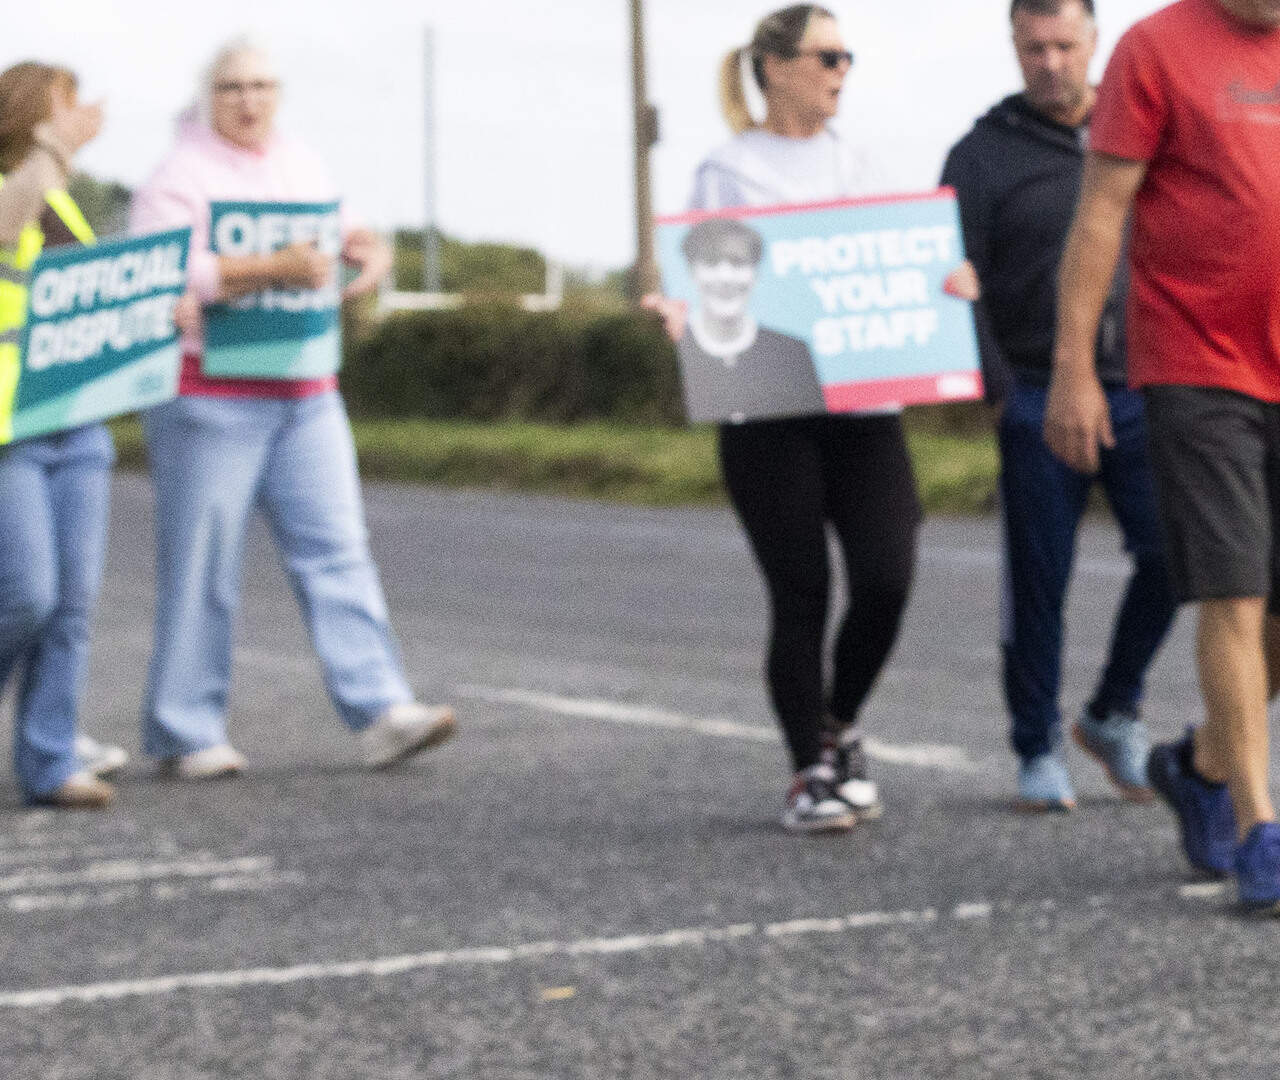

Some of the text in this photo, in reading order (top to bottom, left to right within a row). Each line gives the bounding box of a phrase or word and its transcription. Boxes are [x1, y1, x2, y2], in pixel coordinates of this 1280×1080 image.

[771, 224, 957, 276] PROTECT
[32, 243, 186, 317] OFFICIAL
[811, 270, 926, 314] YOUR
[27, 294, 175, 371] DISPUTE
[811, 308, 938, 356] STAFF
